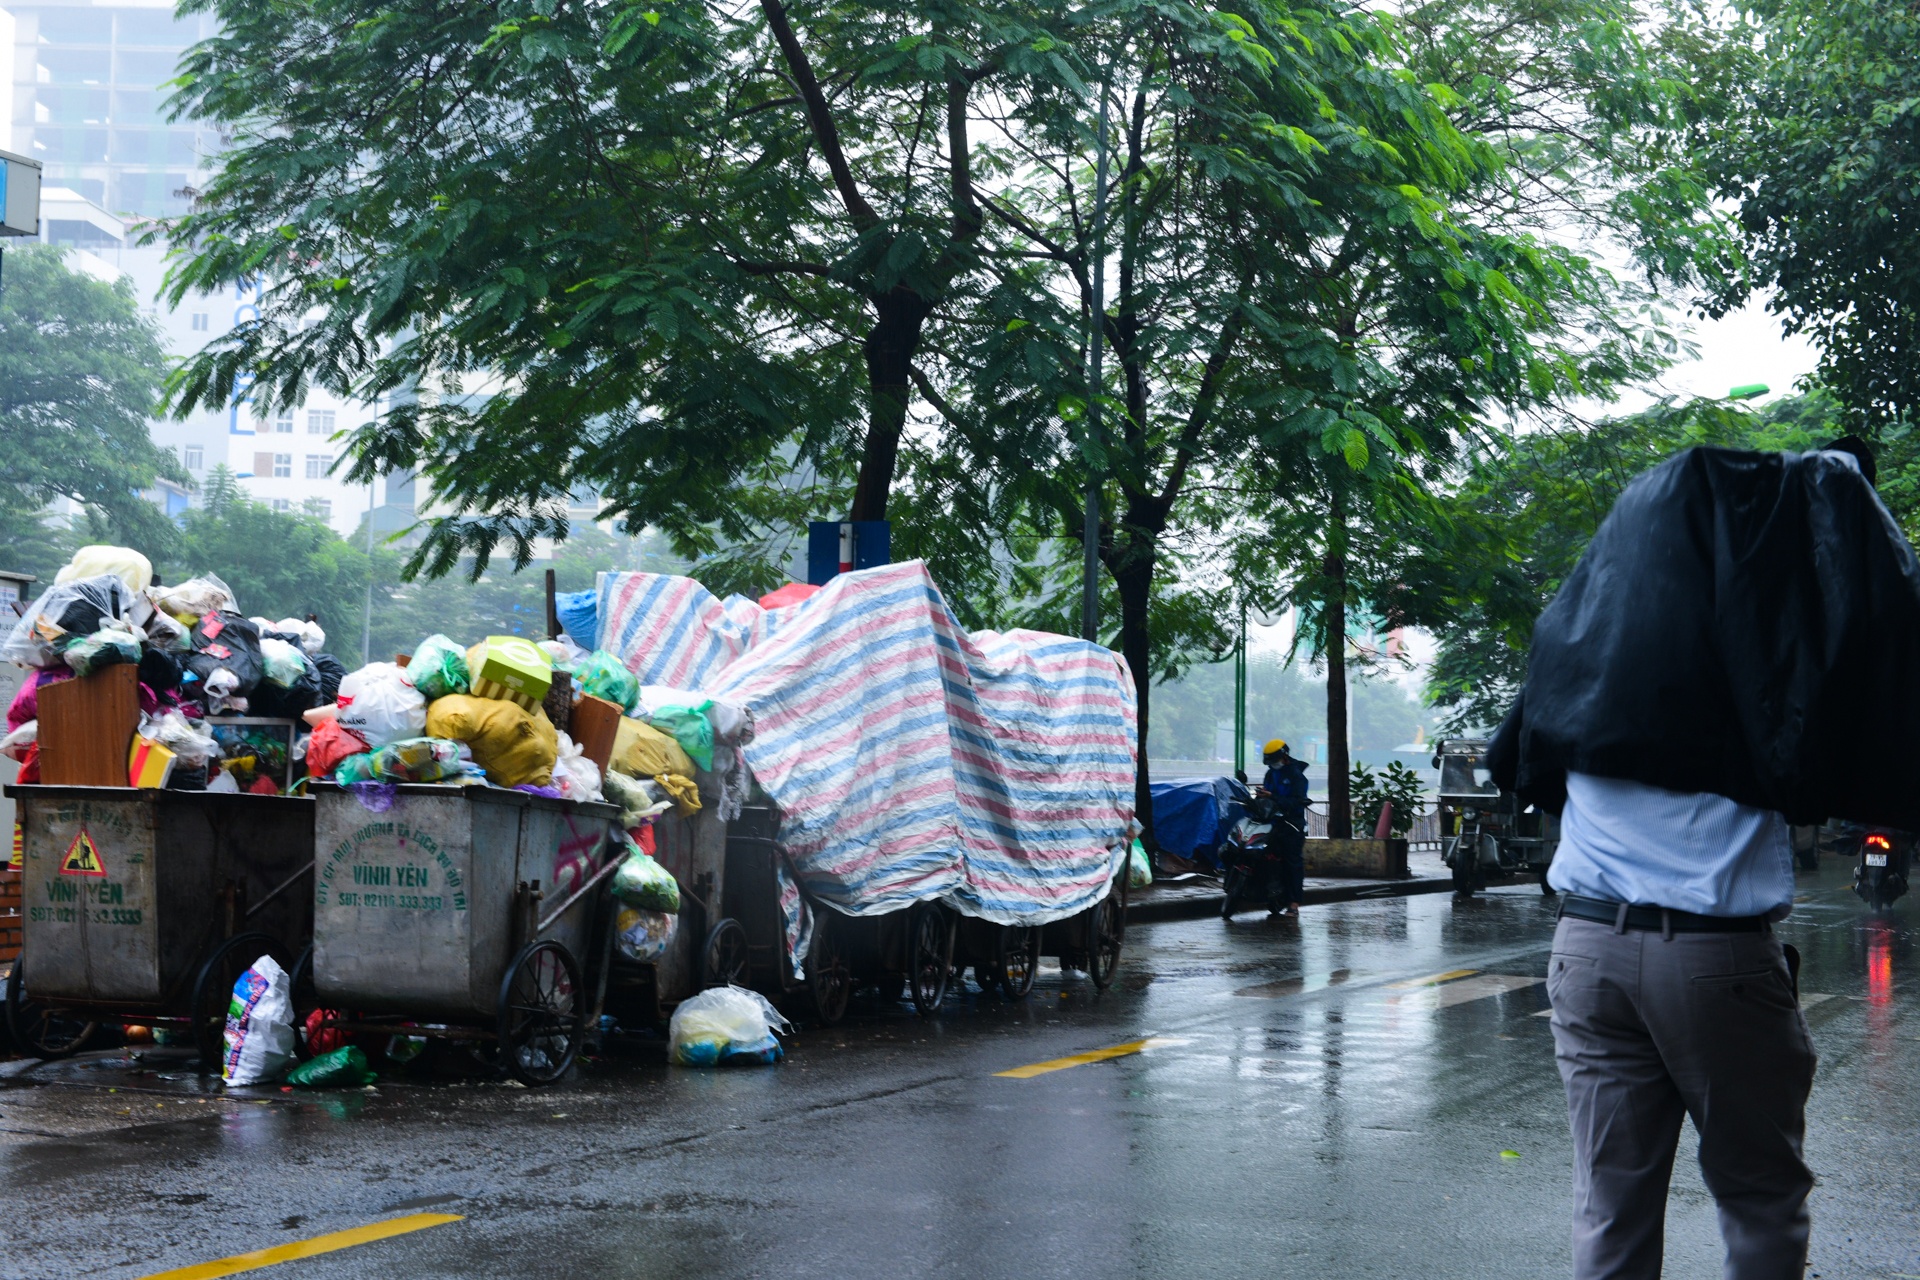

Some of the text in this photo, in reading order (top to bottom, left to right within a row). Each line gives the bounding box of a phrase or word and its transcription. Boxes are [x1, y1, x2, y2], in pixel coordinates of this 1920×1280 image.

[229, 270, 263, 436] HOEL
[395, 861, 428, 888] YÊN
[84, 878, 123, 905] YÊN
